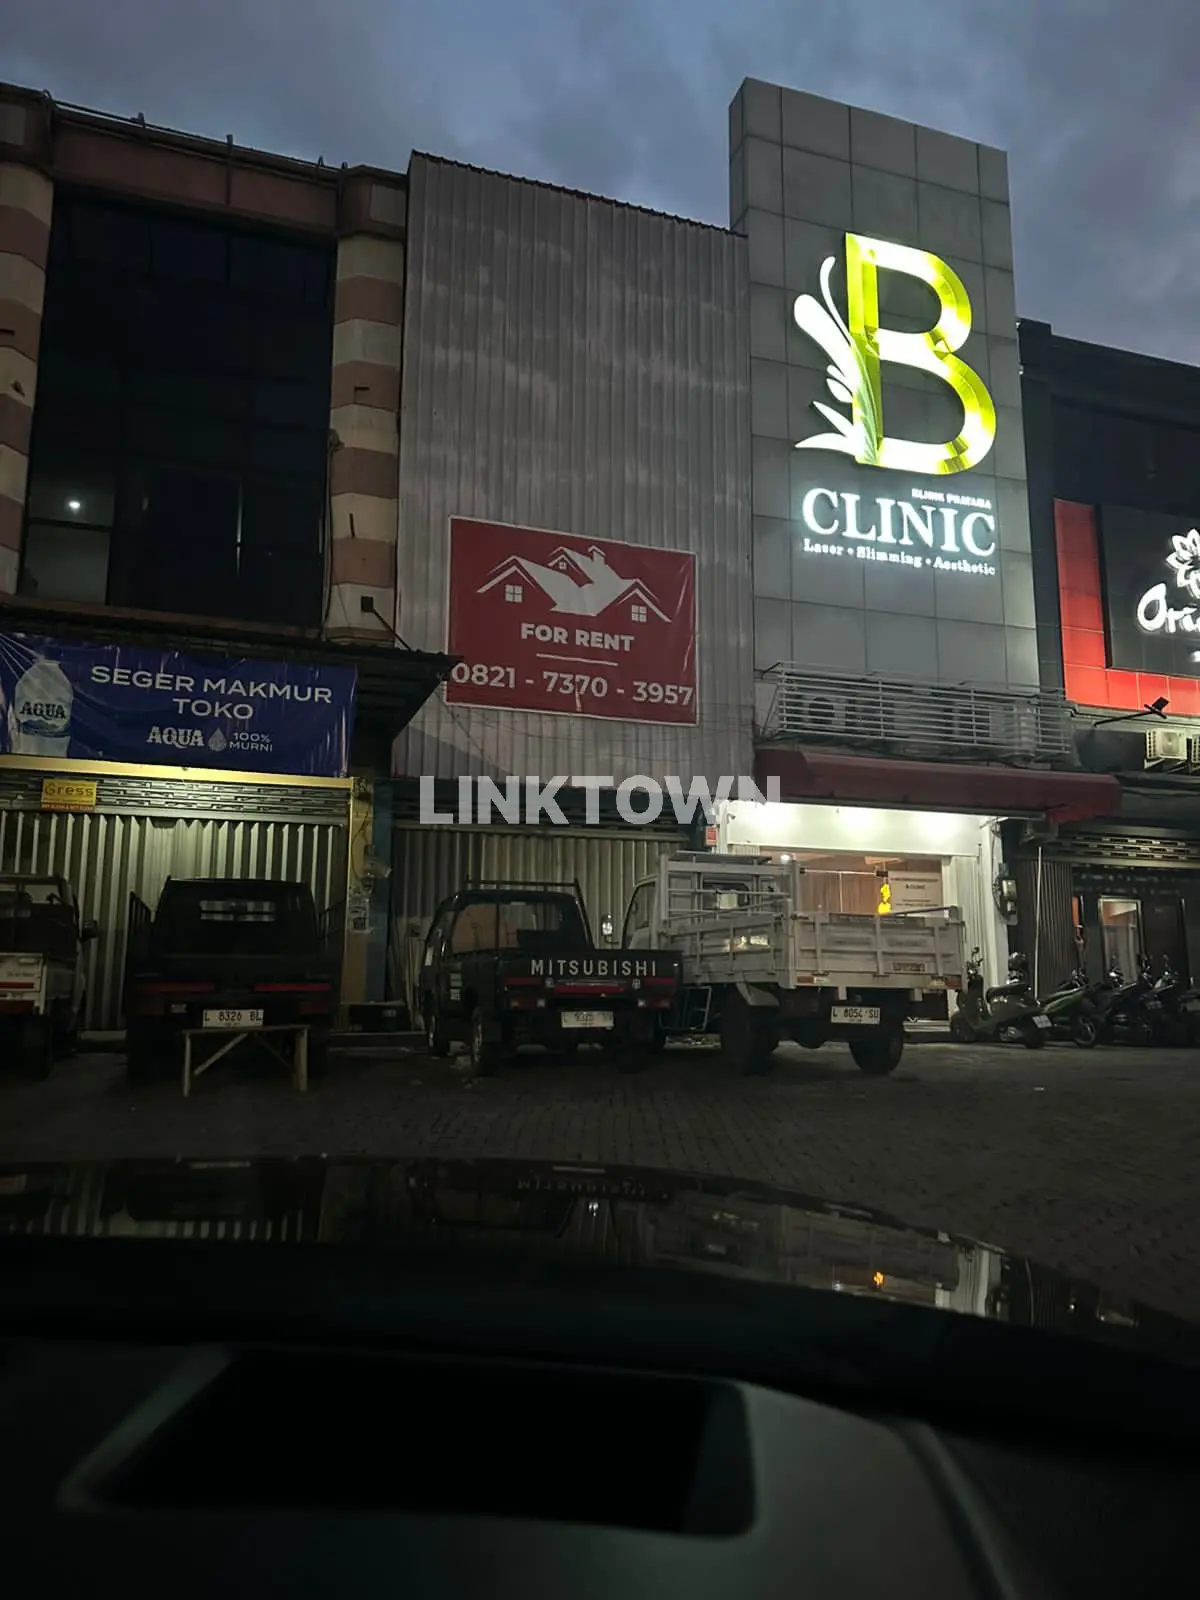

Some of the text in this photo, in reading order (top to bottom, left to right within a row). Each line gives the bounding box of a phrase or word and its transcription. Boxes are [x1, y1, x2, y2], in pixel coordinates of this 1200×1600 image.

[846, 232, 996, 475] B
[802, 488, 995, 557] CLINIC
[803, 538, 996, 576] Laser Slimming Aesthetic
[521, 622, 635, 652] FOR RENT
[90, 666, 333, 704] SEGER MAKMUR
[452, 662, 516, 689] 0821
[543, 672, 608, 698] 7370
[632, 681, 694, 706] 3957
[20, 701, 66, 720] AQUA
[172, 697, 254, 720] TOKO
[147, 726, 205, 749] AQUA
[229, 741, 273, 752] MURNI
[233, 732, 272, 744] 100%
[45, 782, 94, 796] Gress
[531, 959, 657, 977] MITSUBISHI
